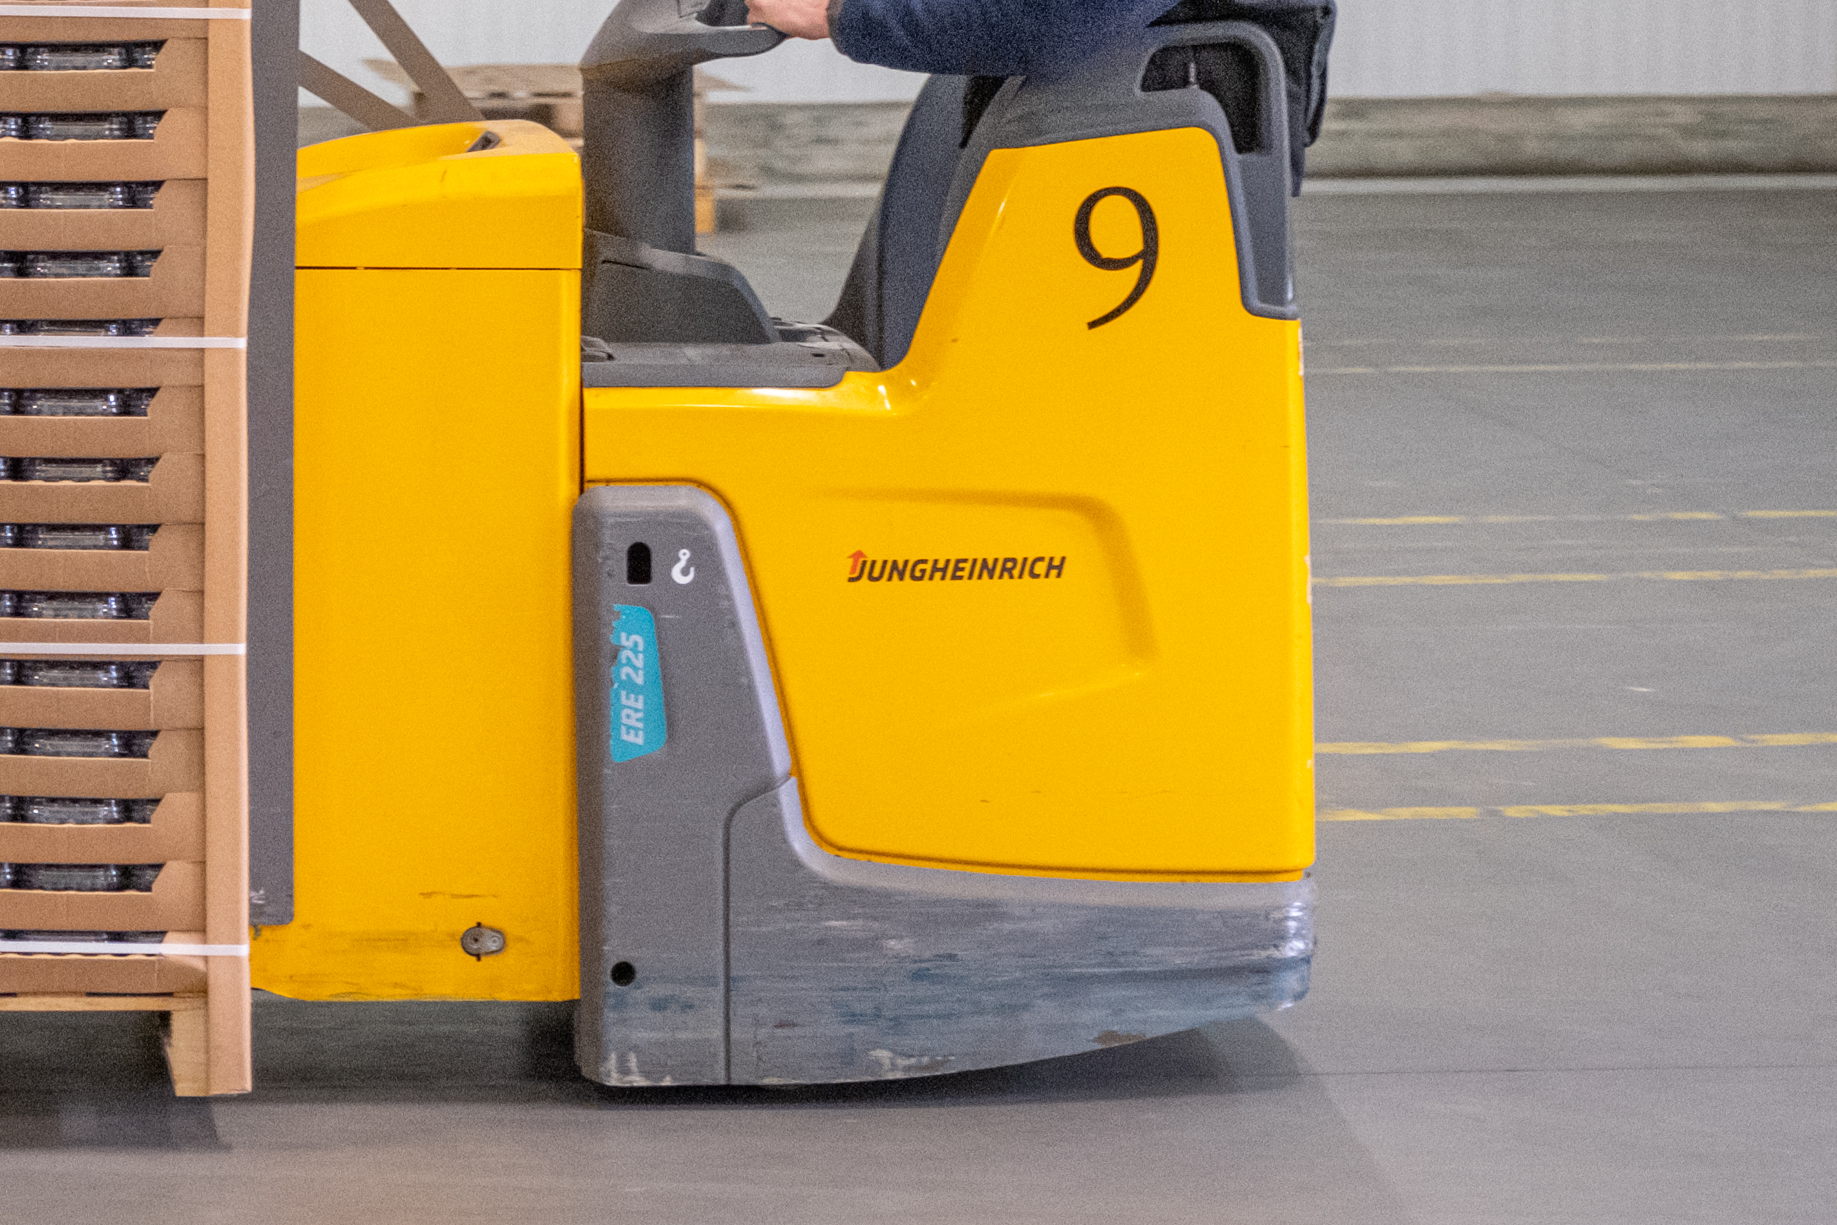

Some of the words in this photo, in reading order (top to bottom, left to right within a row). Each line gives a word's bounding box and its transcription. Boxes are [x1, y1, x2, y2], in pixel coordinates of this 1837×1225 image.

[1074, 186, 1159, 330] 9
[847, 554, 1066, 583] JUNGHEINRICH
[620, 631, 645, 686] 225
[620, 690, 645, 746] ERE
